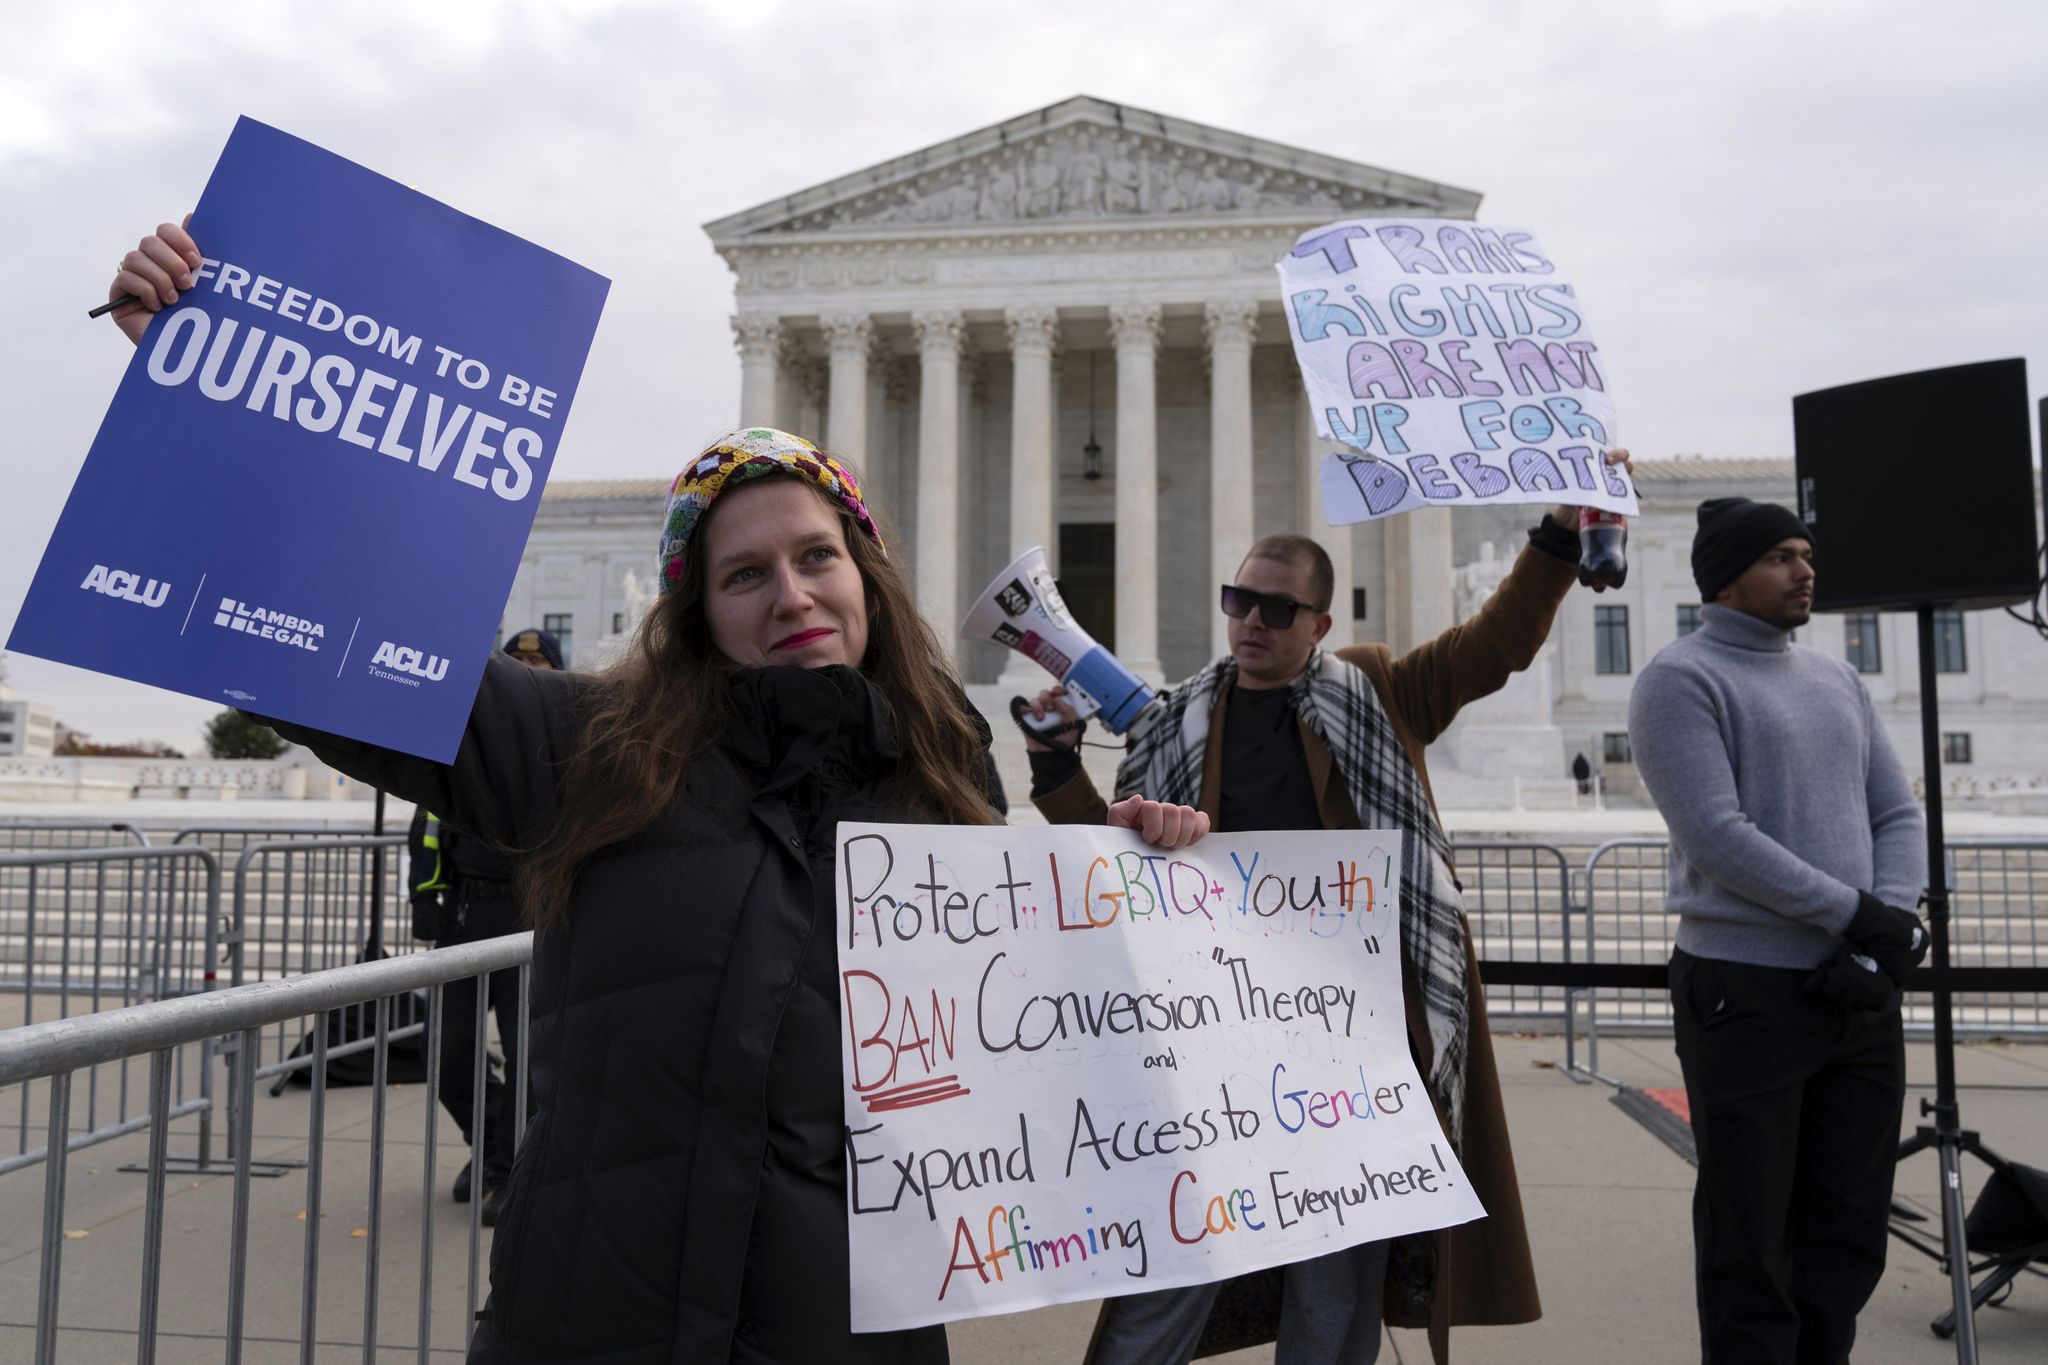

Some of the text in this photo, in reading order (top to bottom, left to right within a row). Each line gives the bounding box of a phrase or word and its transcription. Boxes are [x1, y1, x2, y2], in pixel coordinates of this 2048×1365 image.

[1291, 225, 1556, 275] TRANS
[191, 257, 558, 420] FREEDOM TO BE
[1346, 338, 1605, 400] ARE NOT
[147, 307, 544, 502] OURSELVES
[1325, 397, 1608, 461] UP FOR
[1346, 446, 1629, 516] DEBATE
[80, 564, 172, 608] ACLU
[235, 602, 325, 639] LAMBDA
[245, 620, 320, 653] LEGAL
[367, 665, 421, 688] Tennessee
[371, 640, 450, 682] ACLU
[843, 834, 1032, 950] Protect
[1230, 852, 1392, 917] Youth!
[842, 970, 956, 1092] BAN
[976, 951, 1221, 1052] Conversion
[1143, 1047, 1177, 1071] and
[845, 1062, 1411, 1222] Expand Access to Gender
[937, 1143, 1454, 1301] Affirming Care Everywhere!
